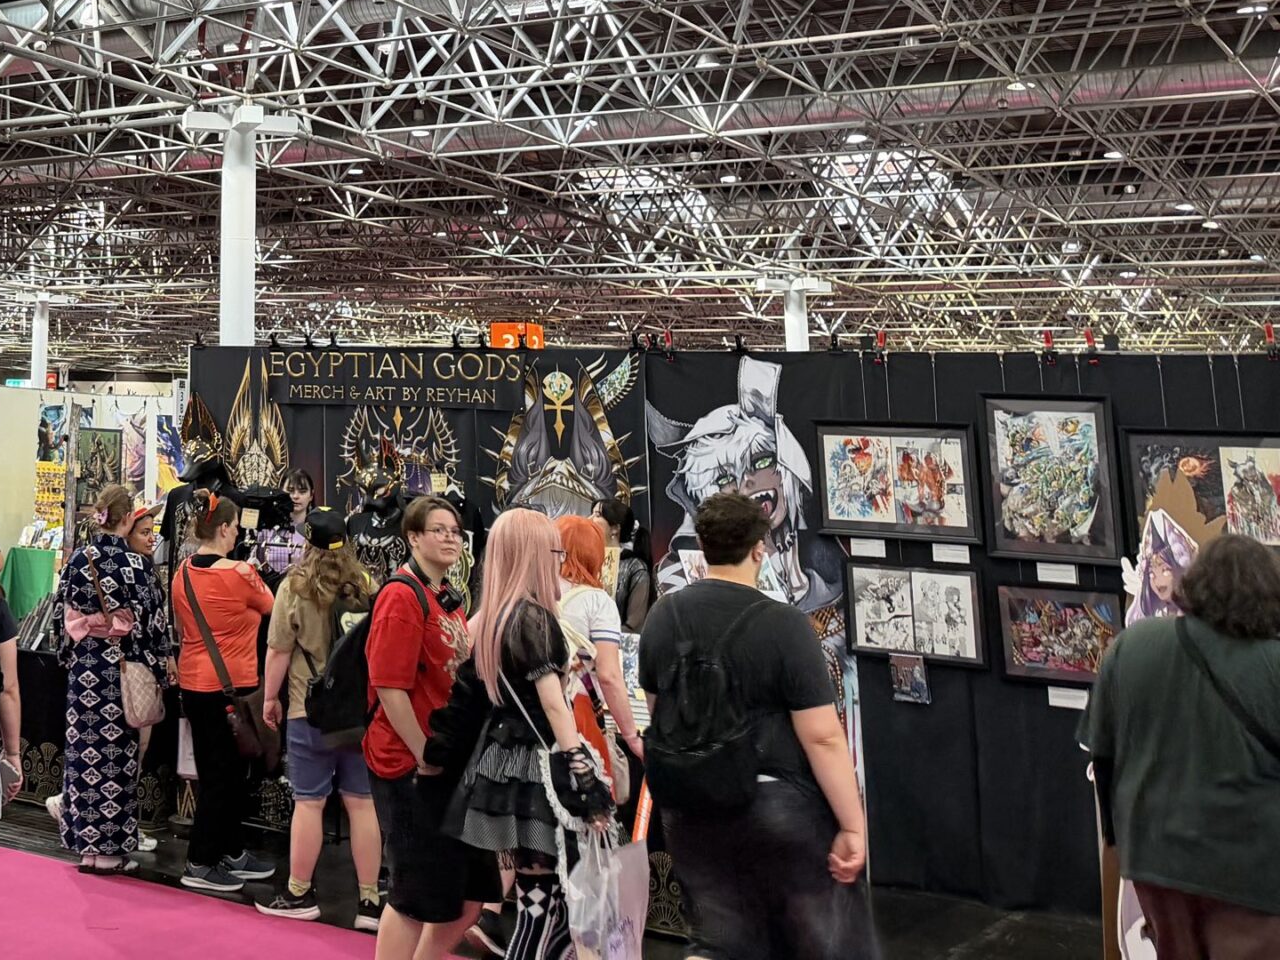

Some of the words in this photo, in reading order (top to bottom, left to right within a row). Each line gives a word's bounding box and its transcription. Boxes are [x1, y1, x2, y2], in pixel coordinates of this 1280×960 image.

[269, 351, 424, 380] EGYPTIAN
[433, 352, 521, 382] GODS
[289, 384, 344, 400] MERCH
[349, 385, 361, 400] &
[364, 386, 396, 401] ART
[402, 387, 421, 402] BY
[426, 387, 496, 404] REYHAN
